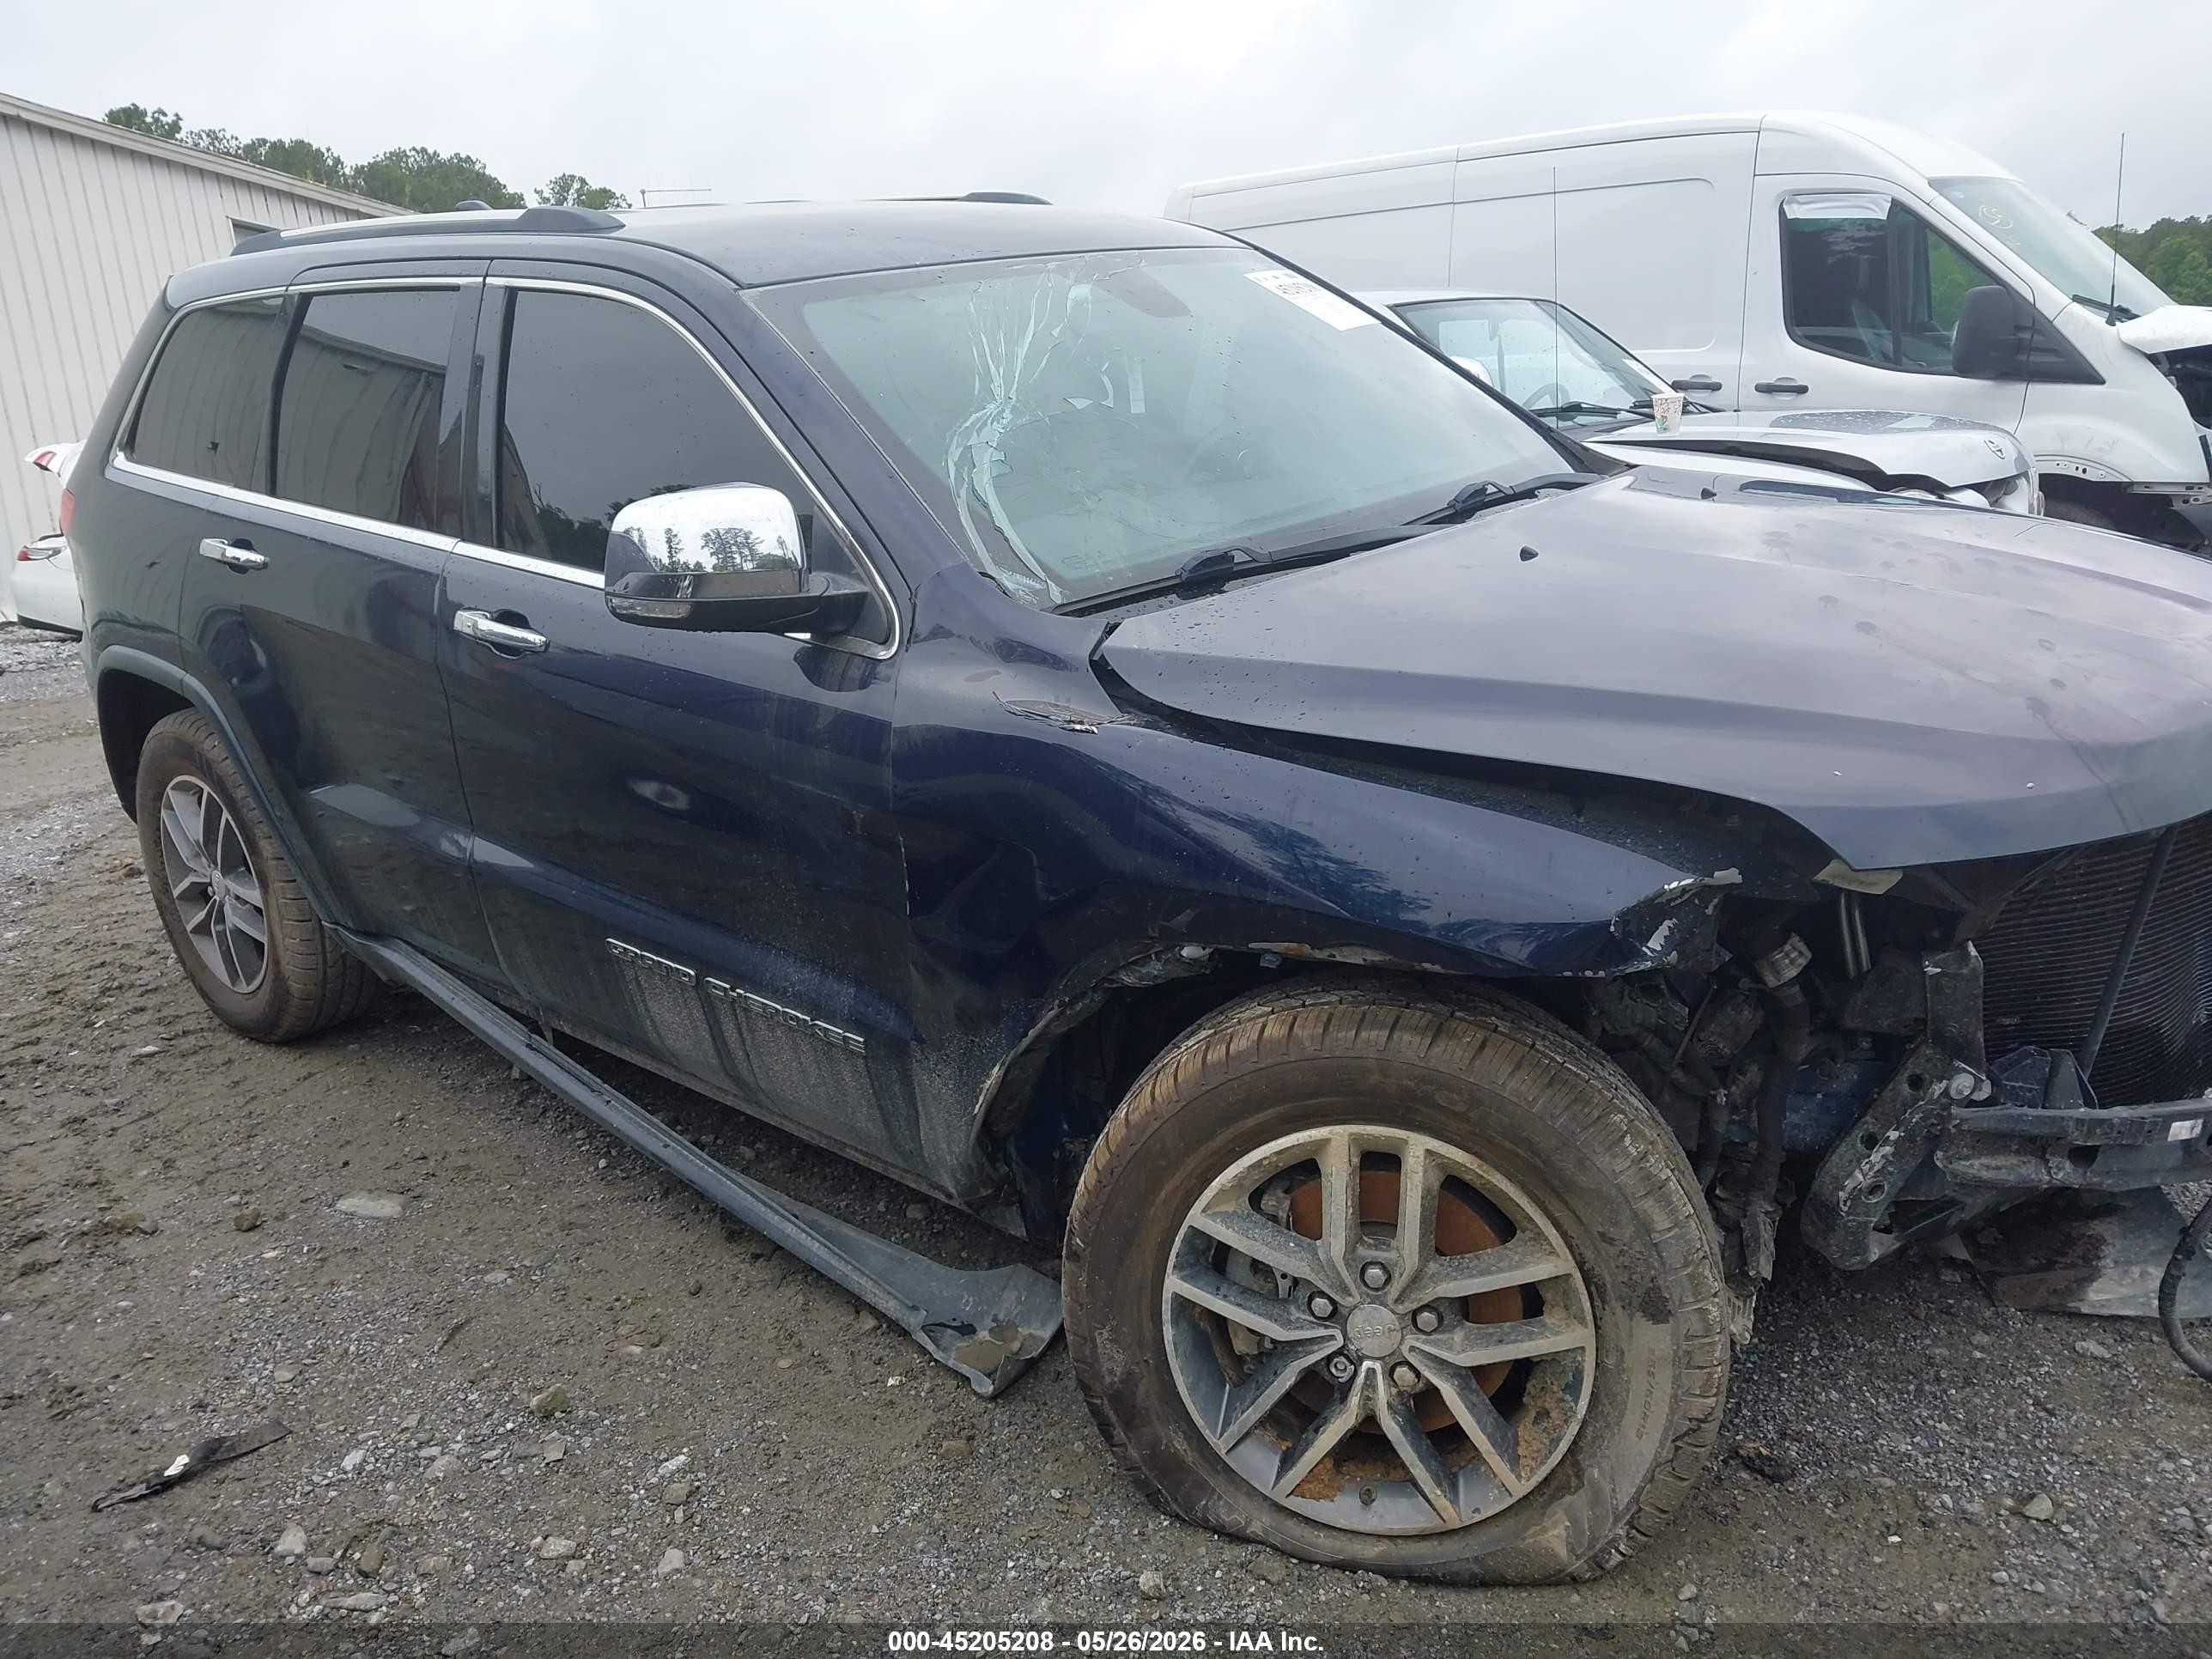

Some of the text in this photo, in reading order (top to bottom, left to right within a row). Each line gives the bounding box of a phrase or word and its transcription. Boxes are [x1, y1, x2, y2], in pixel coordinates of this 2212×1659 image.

[605, 938, 866, 1053] GRAND CHEROKEE
[1353, 1323, 1397, 1339] Jeep
